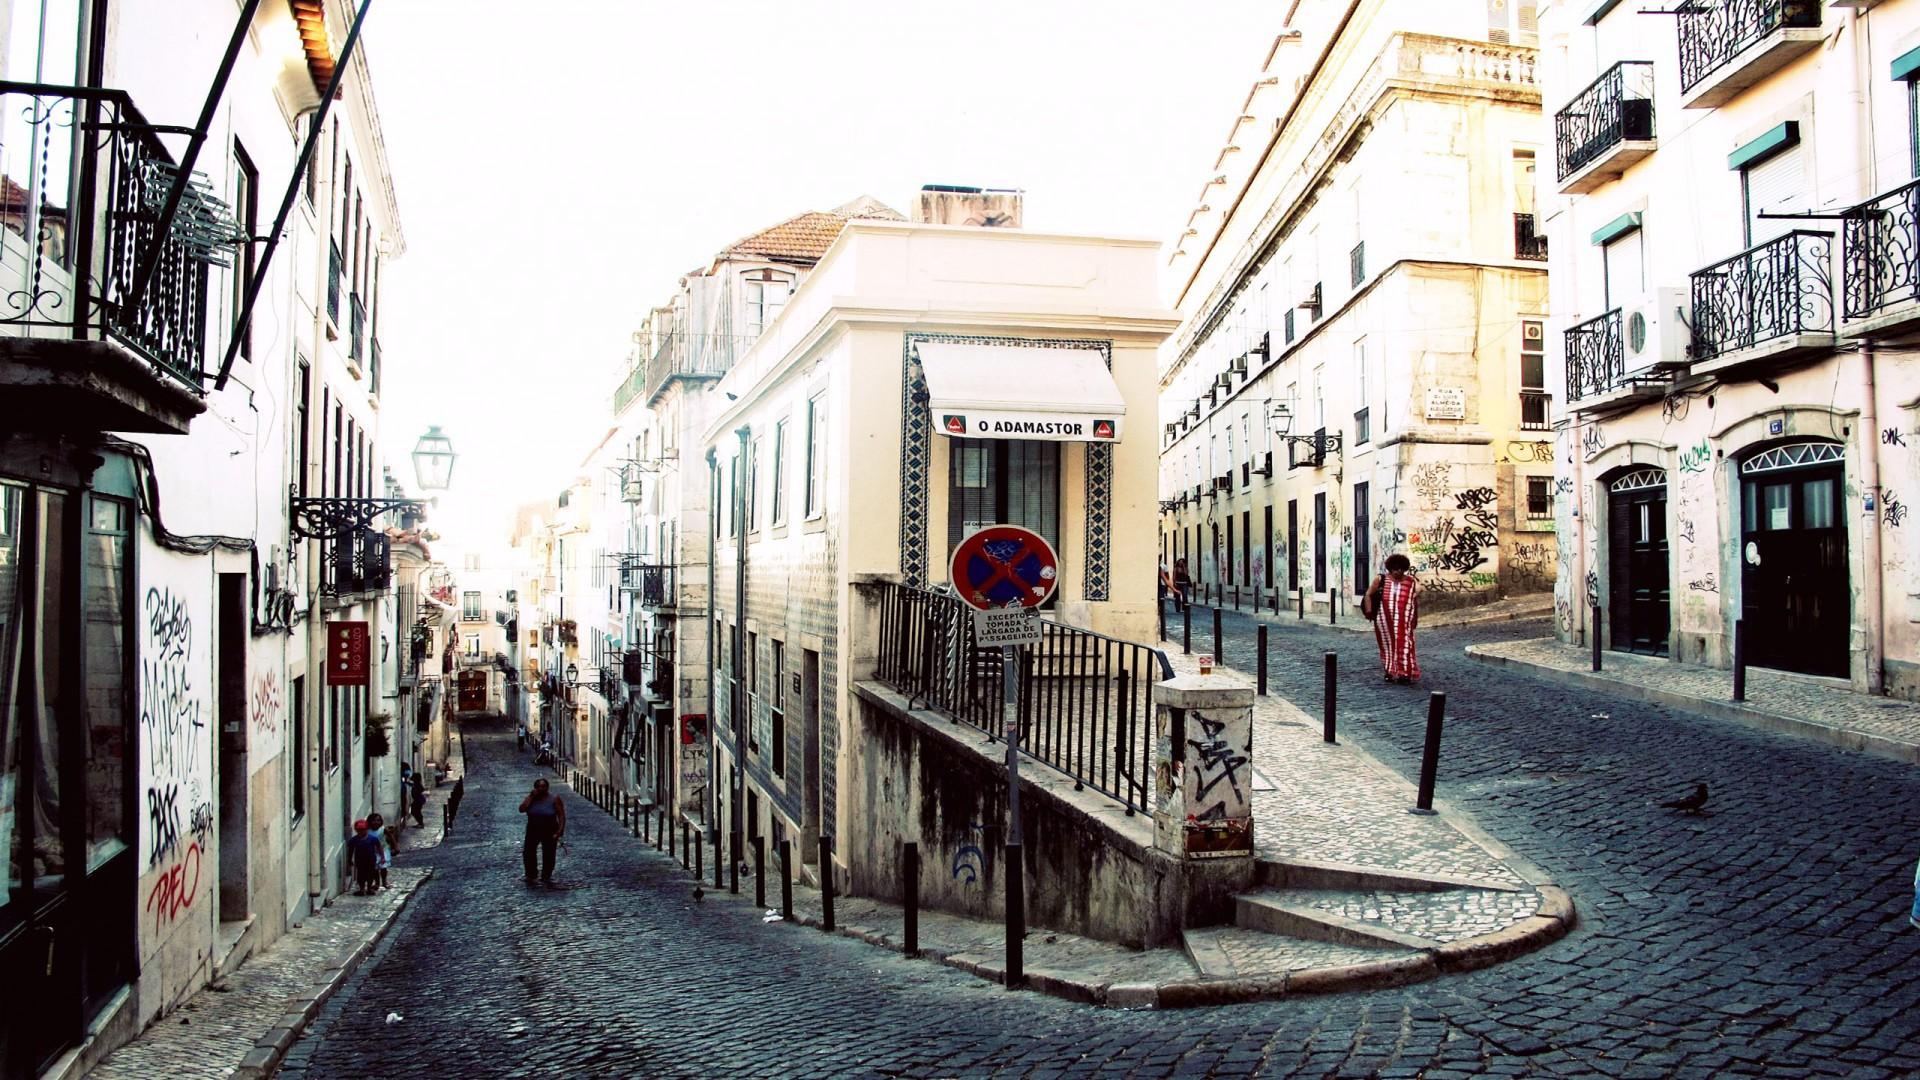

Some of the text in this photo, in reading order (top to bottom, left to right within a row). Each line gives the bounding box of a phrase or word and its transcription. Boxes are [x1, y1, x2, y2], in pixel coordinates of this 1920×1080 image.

[978, 420, 1082, 435] O ADAMASTOR
[987, 613, 1026, 621] EXCEPTO
[986, 620, 1022, 629] TOMADA
[981, 627, 1022, 636] LARGADA
